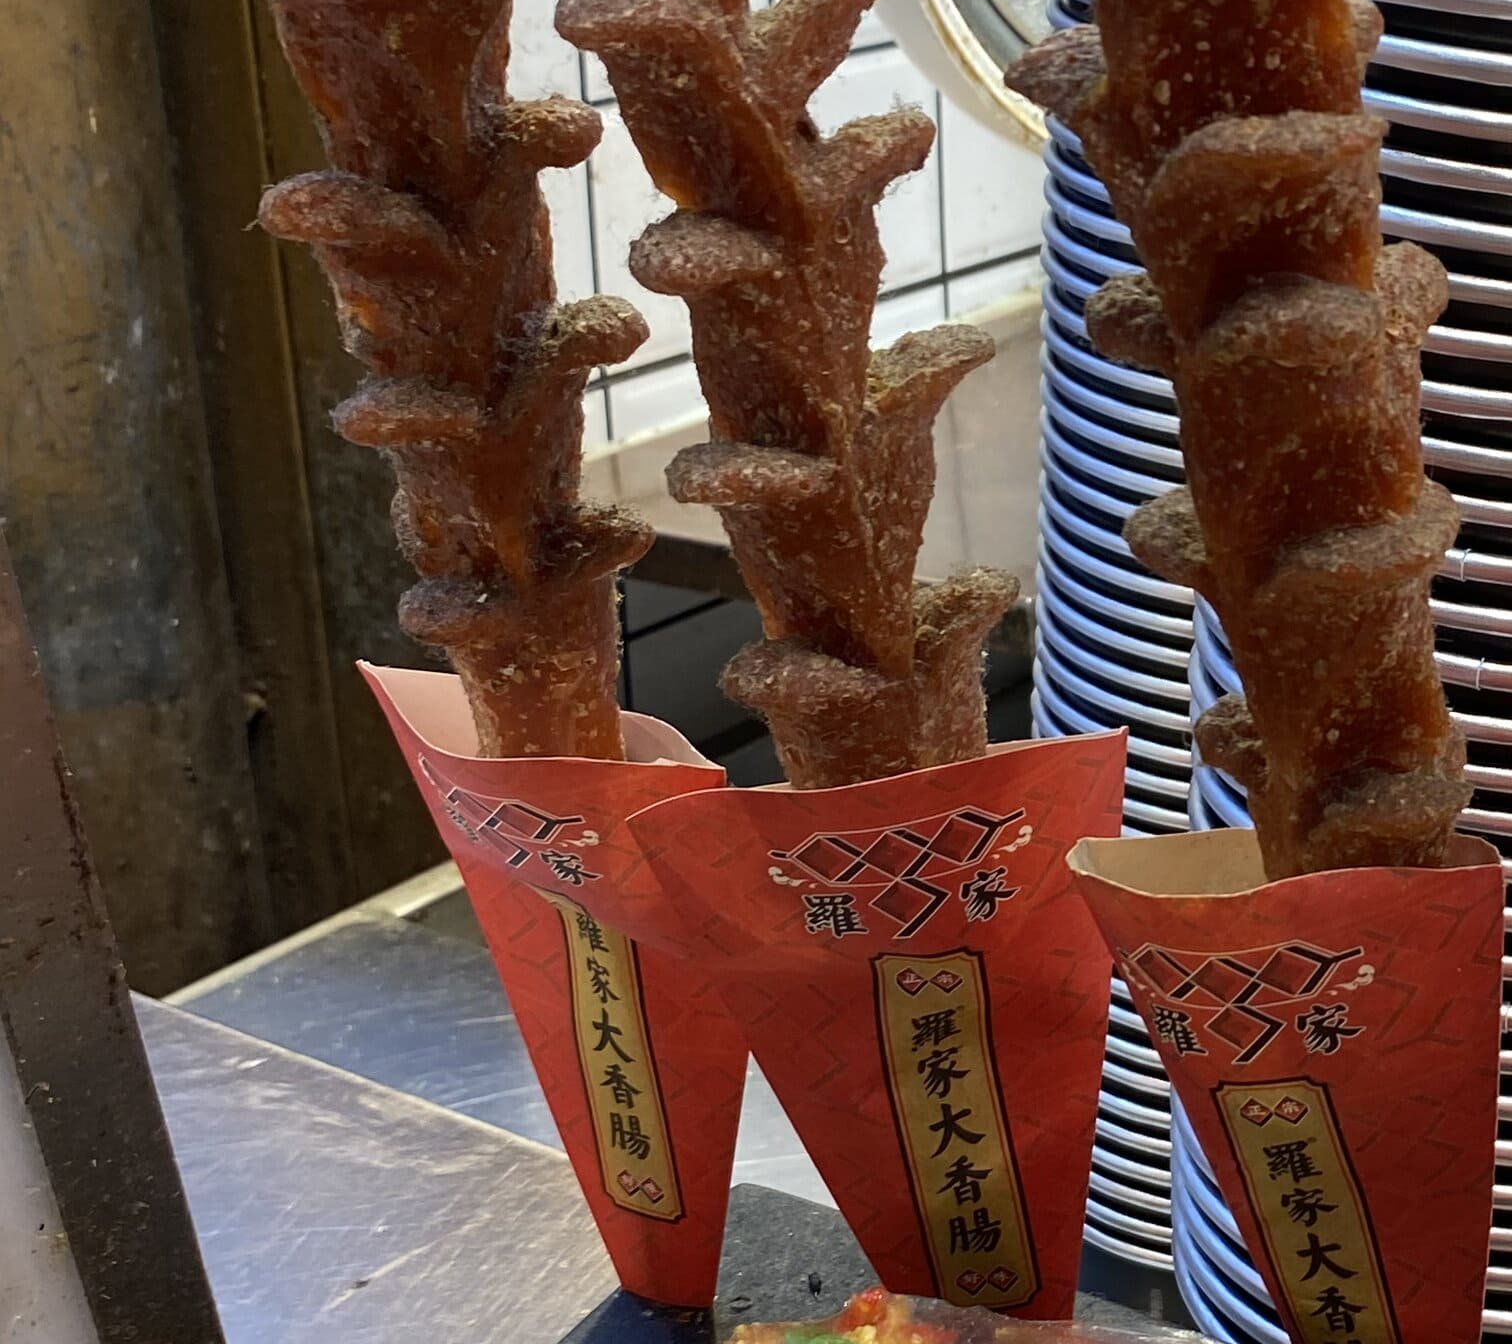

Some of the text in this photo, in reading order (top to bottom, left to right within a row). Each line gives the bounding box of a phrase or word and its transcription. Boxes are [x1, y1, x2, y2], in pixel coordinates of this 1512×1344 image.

[960, 867, 1021, 922] 家
[576, 911, 651, 1160] 羅家大香腸
[1295, 1004, 1366, 1055] 家
[911, 1006, 1001, 1256] 羅家大香腸
